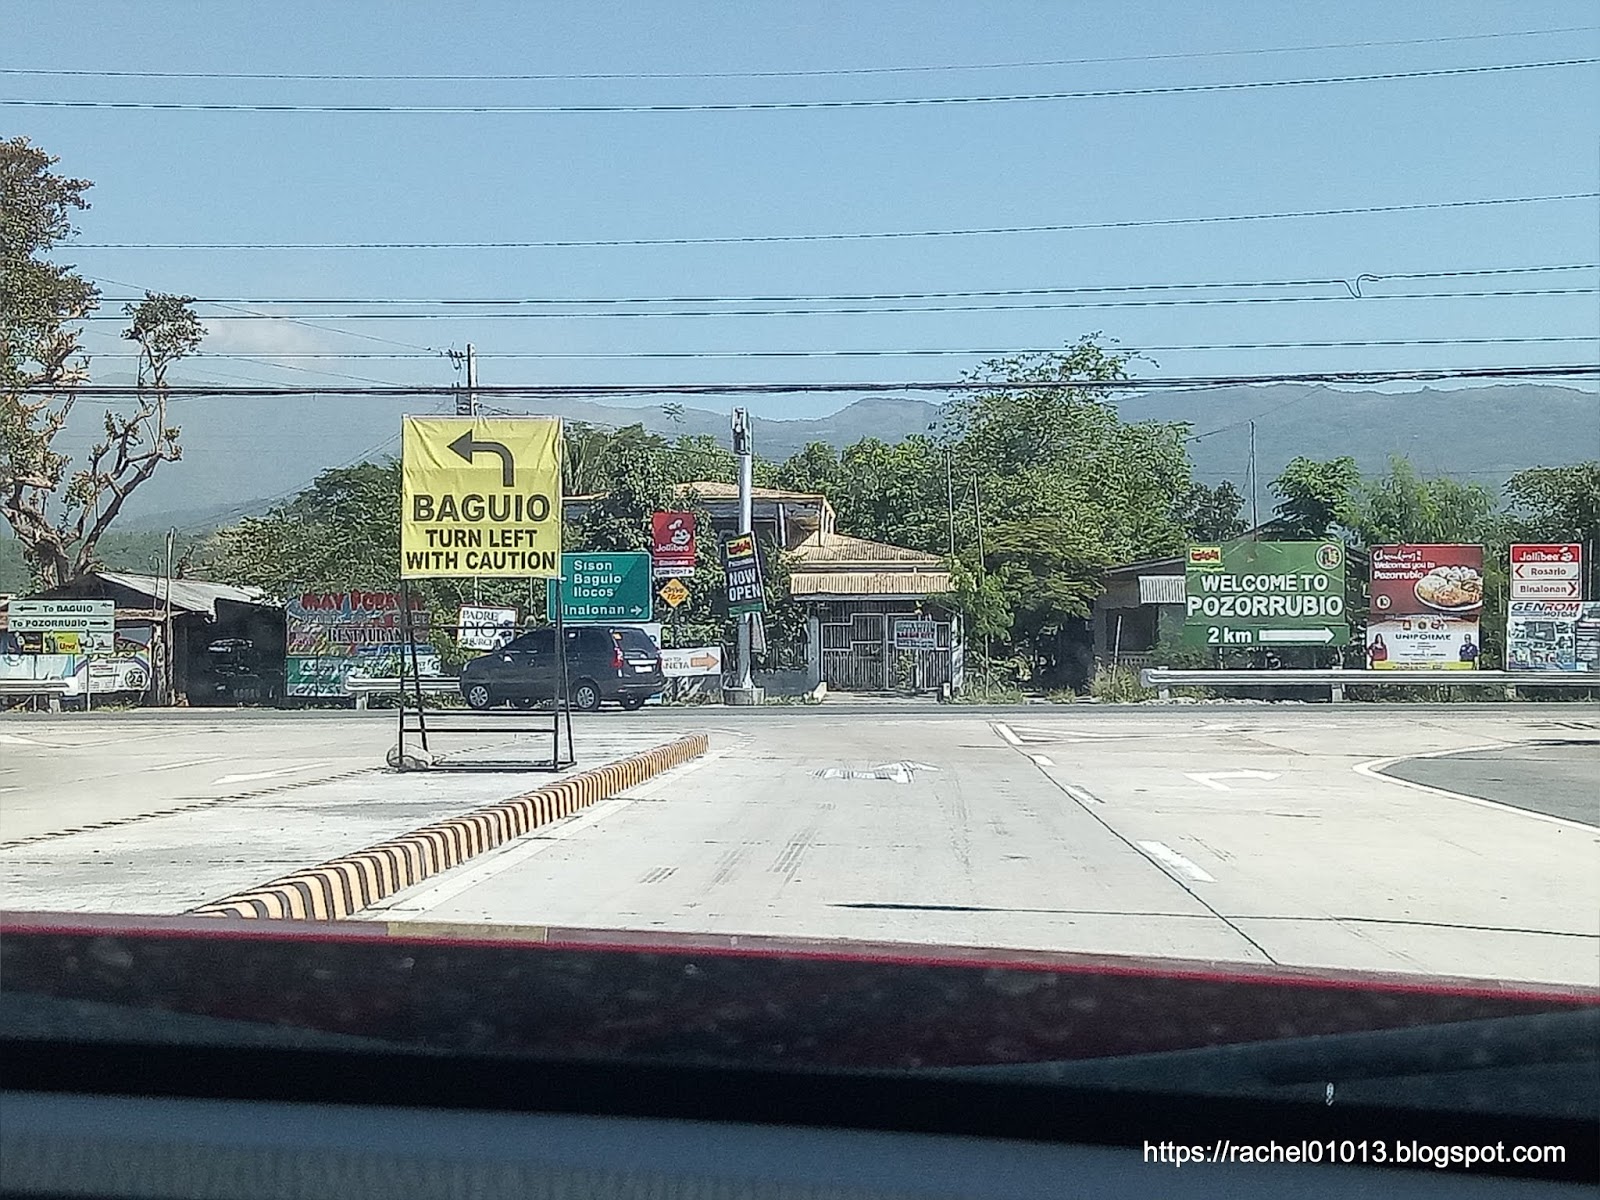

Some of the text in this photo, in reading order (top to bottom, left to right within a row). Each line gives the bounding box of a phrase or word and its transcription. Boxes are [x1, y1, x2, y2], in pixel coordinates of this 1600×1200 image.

[413, 494, 551, 522] BAGUIO
[425, 529, 538, 548] TURN LEFT
[655, 543, 689, 552] Jollibee
[406, 551, 556, 570] WITH CAUTION
[1519, 551, 1561, 561] Jollibee
[573, 560, 612, 571] Sison
[1530, 567, 1567, 576] Rosario
[573, 573, 622, 585] Baguio
[729, 568, 756, 587] NOW
[1201, 574, 1329, 592] WELCOME TO
[573, 587, 614, 598] Ilocos
[729, 582, 761, 602] OPEN
[1520, 584, 1567, 593] Binalonan
[42, 605, 93, 613] To BAGUIO
[1187, 595, 1343, 617] POZORRUBIO
[1511, 602, 1580, 611] GENROM
[463, 610, 498, 621] PADRE
[11, 619, 88, 627] To POZORRUBIO
[463, 621, 497, 637] PIO
[1207, 627, 1252, 644] 2 km
